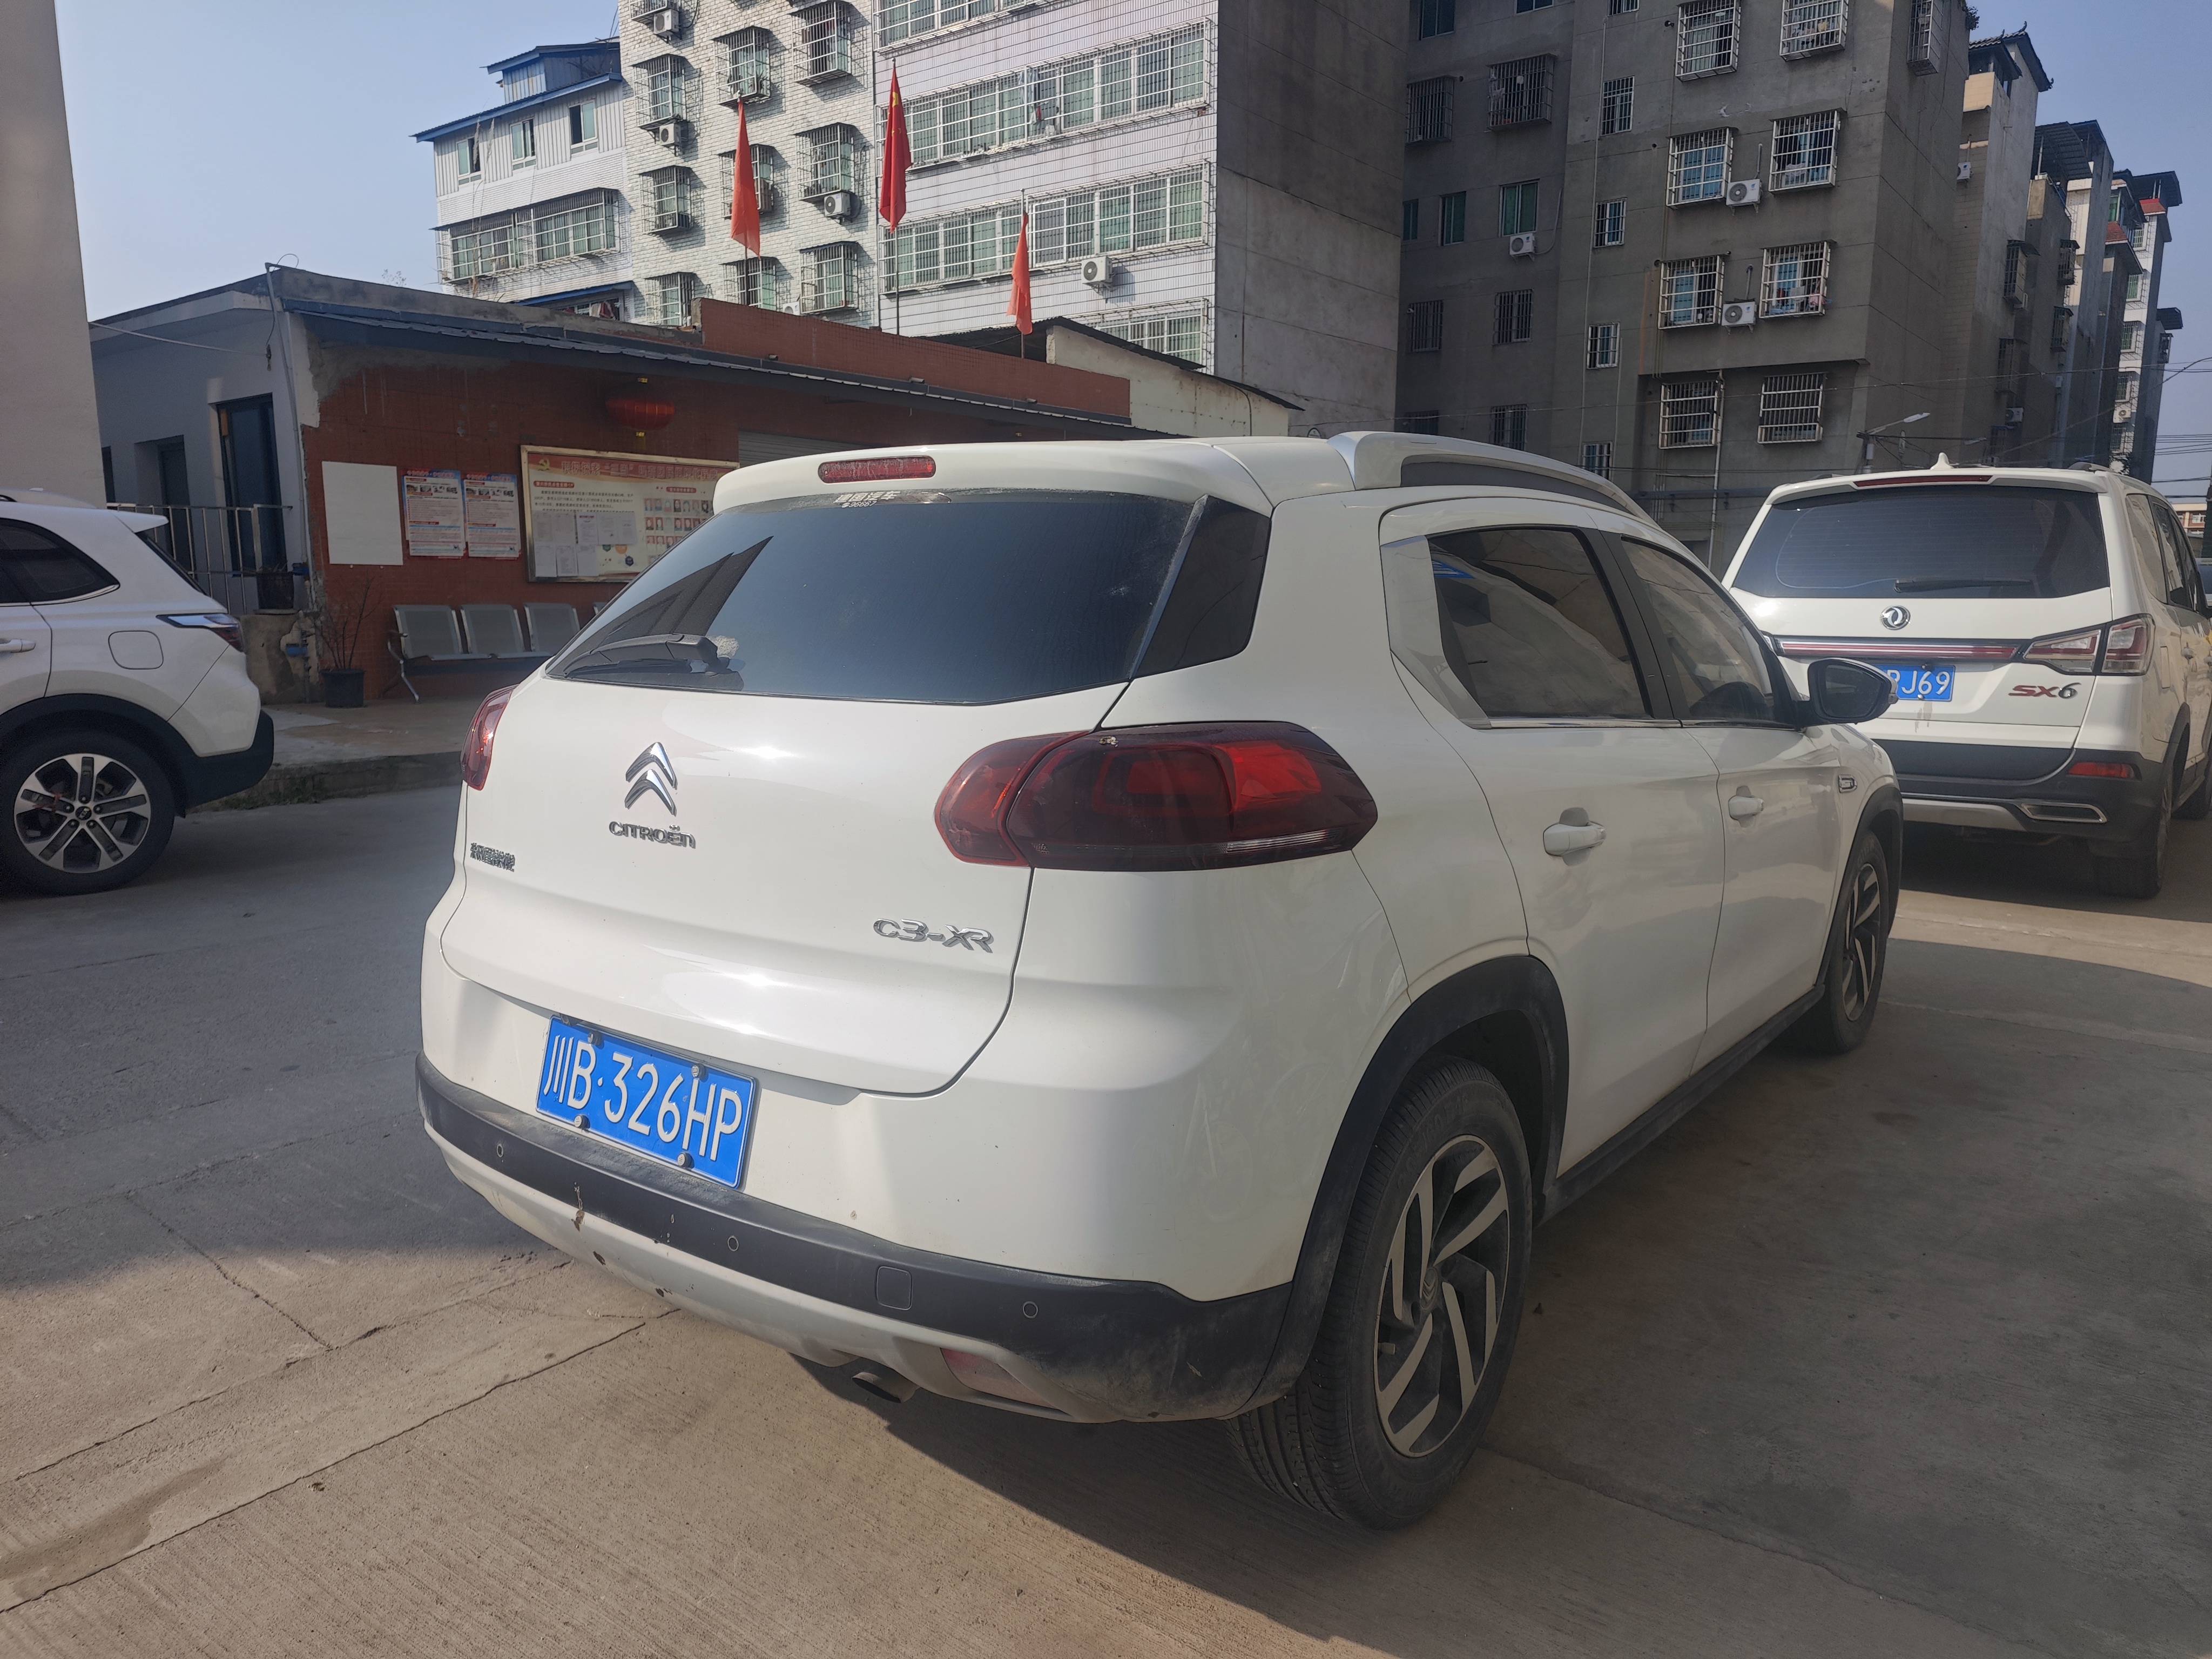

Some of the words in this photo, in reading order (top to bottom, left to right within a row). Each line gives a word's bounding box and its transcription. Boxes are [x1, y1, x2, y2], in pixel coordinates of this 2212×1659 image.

[834, 491, 901, 503] 建国汽车
[2008, 683, 2082, 699] SX6
[873, 918, 994, 953] C3-XR
